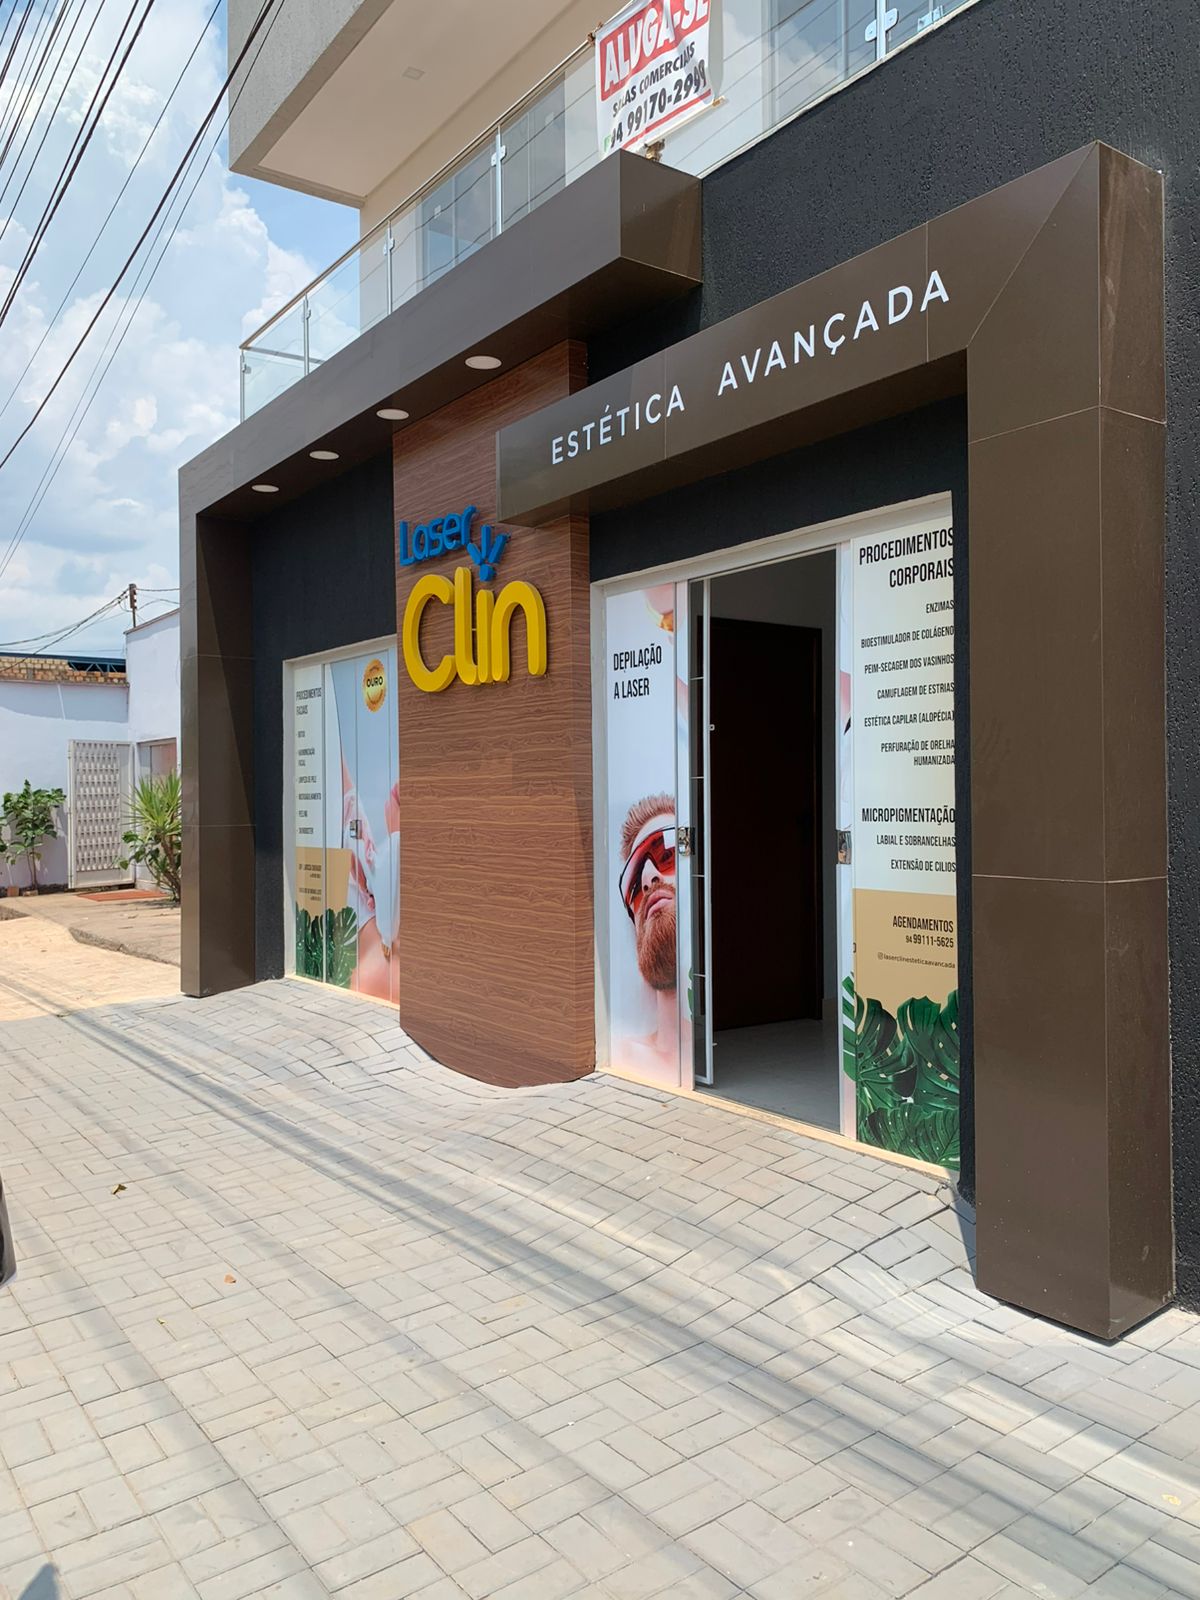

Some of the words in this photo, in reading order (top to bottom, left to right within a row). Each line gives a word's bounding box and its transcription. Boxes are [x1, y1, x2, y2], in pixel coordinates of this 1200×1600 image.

[551, 384, 686, 465] ESTÉTICA
[717, 269, 950, 397] AVANÇADA
[400, 504, 477, 566] Laser
[859, 527, 954, 565] PROCEDIMENTOS
[889, 557, 954, 588] CORPORAIS
[925, 599, 954, 614] ENZIMAS
[402, 566, 548, 692] Clin
[860, 631, 911, 649] BIOESTIMULADOR
[911, 630, 920, 641] DE
[921, 625, 955, 639] COLÁGENO
[613, 643, 662, 671] DEPILAÇÃO
[864, 659, 909, 675] PEIM-SECAGEM
[909, 658, 922, 669] DOS
[923, 653, 955, 667] VASINHOS
[366, 675, 383, 687] OURO
[613, 681, 620, 700] A
[621, 677, 650, 699] LASER
[877, 685, 918, 700] CAMUFLAGEM
[918, 684, 928, 696] DE
[928, 682, 955, 695] ESTRIAS
[864, 713, 891, 728] ESTÉTICA
[892, 712, 918, 726] CAPILAR
[918, 709, 955, 724] (ALOPÉCIA)
[880, 739, 920, 754] PERFURAÇÃO
[920, 740, 930, 751] DE
[930, 738, 955, 750] ORELHA
[913, 755, 955, 766] HUMANIZADA
[861, 805, 956, 826] MICROPIGMENTAÇÃO
[876, 834, 898, 846] LABIAL
[899, 835, 904, 846] E
[904, 835, 956, 847] SOBRANCELHAS
[890, 859, 924, 871] EXTENSÃO
[924, 860, 933, 872] DE
[934, 860, 956, 873] CILIOS
[892, 915, 954, 933] AGENDAMENTOS
[905, 935, 912, 944] 94
[912, 933, 954, 948] 99111-5625
